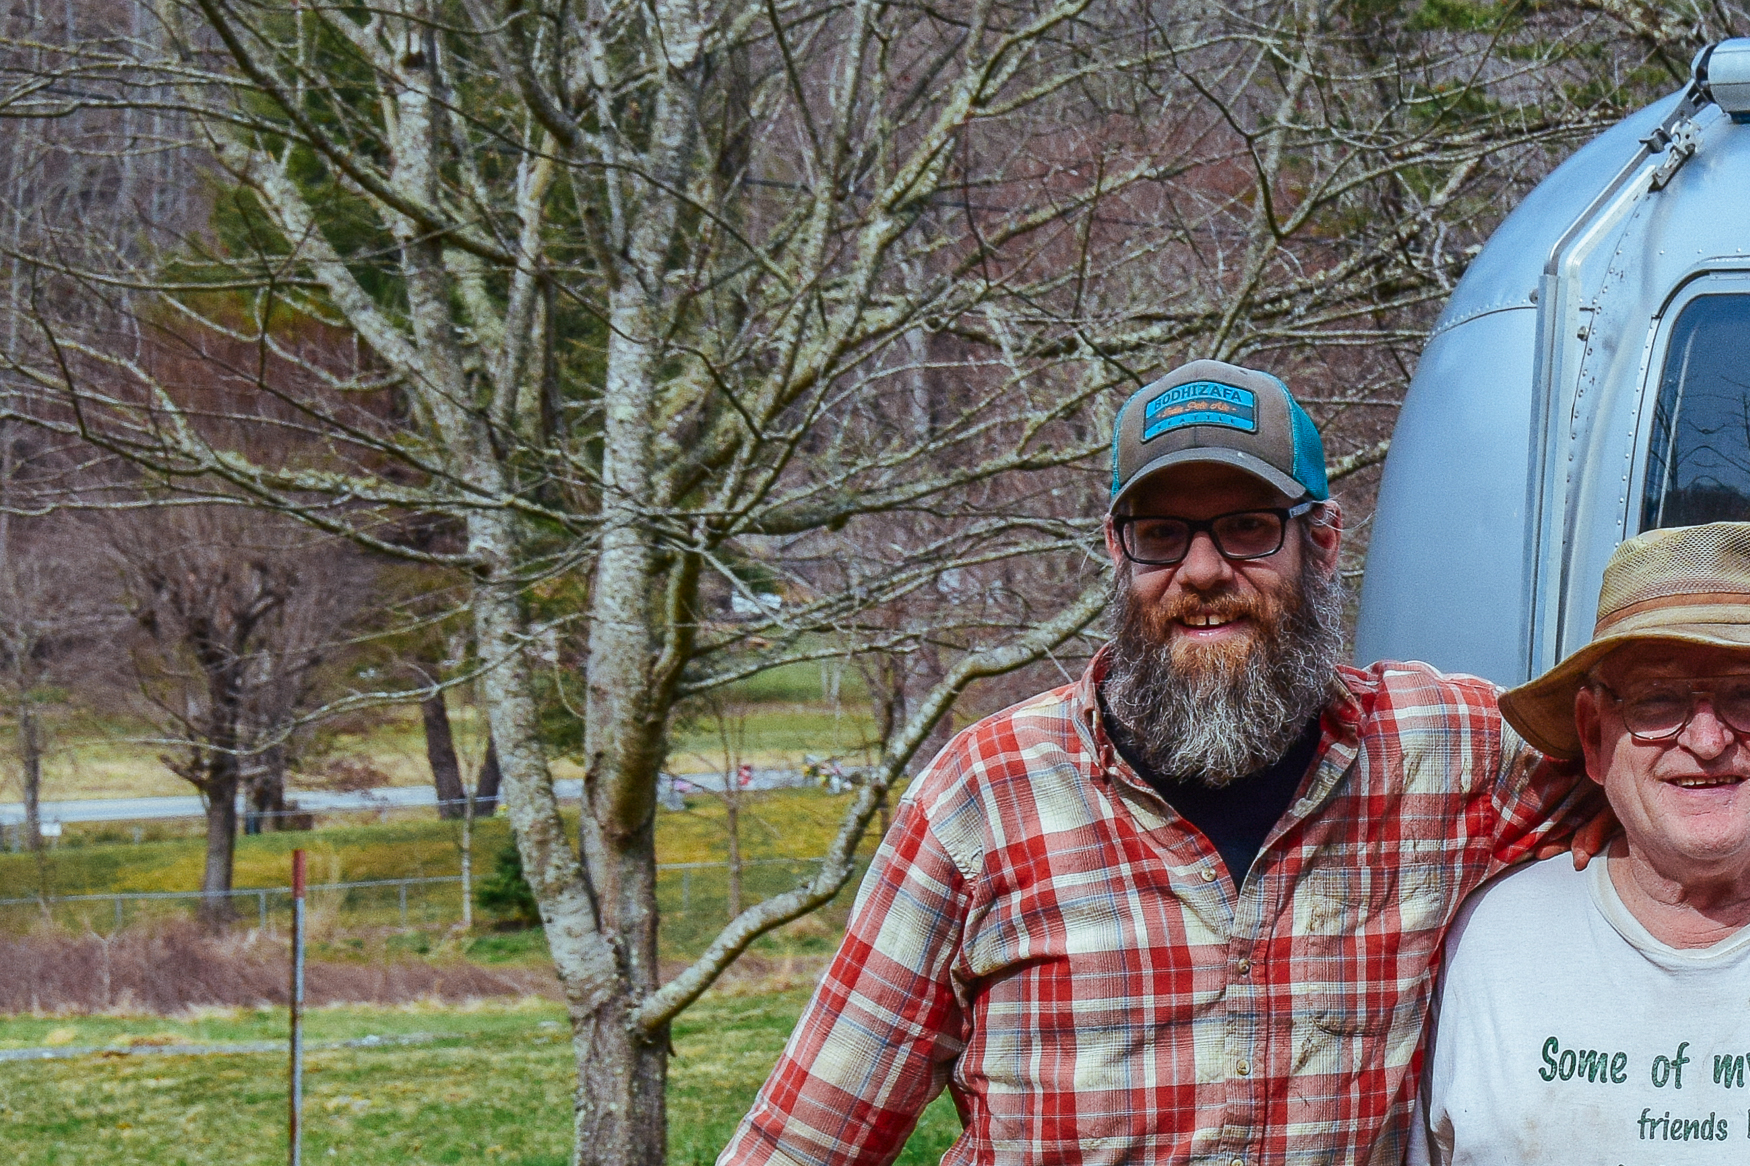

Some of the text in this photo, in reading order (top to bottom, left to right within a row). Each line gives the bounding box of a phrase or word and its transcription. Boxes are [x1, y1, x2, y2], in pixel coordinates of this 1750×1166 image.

[1154, 384, 1242, 410] BODHIZAFA
[1538, 1036, 1628, 1084] Some
[1651, 1041, 1691, 1090] of
[1637, 1108, 1728, 1142] friends
